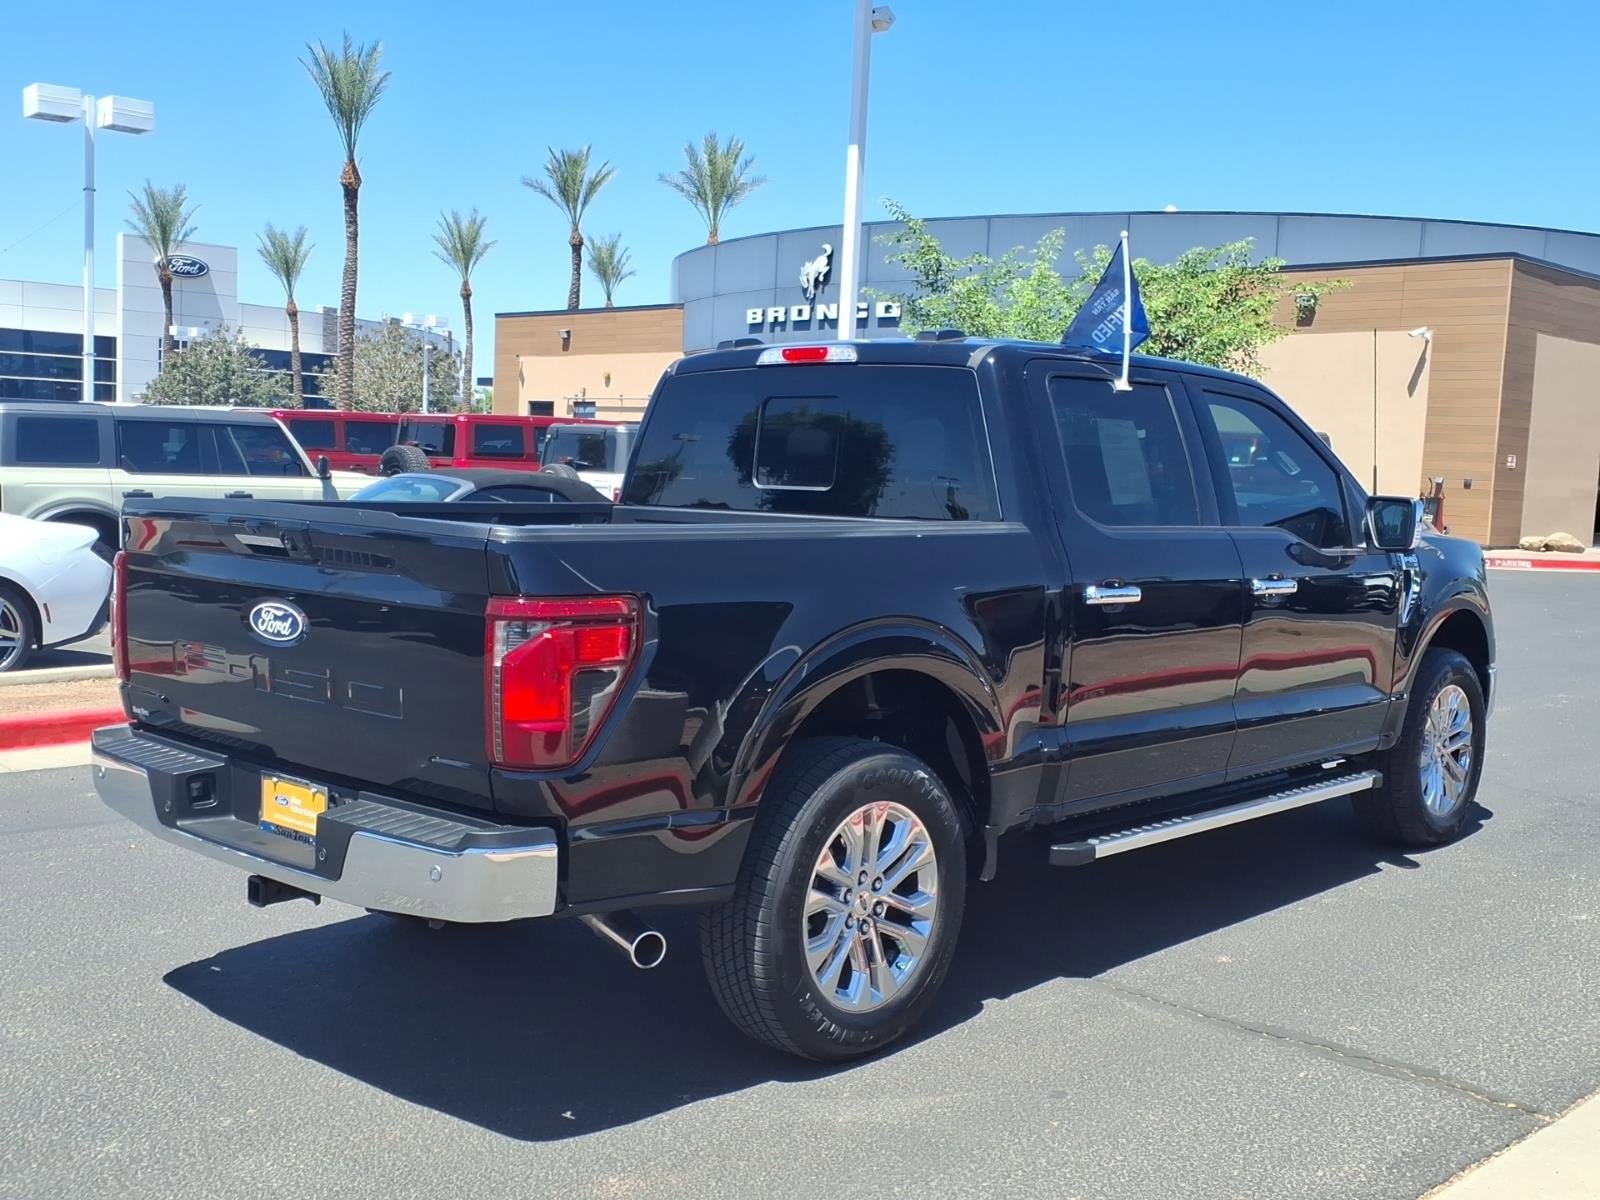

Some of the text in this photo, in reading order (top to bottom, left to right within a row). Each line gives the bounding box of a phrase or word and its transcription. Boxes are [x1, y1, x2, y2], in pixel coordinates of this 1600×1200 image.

[168, 258, 200, 274] Ford
[1495, 560, 1532, 569] PARKING
[257, 606, 293, 636] Ford
